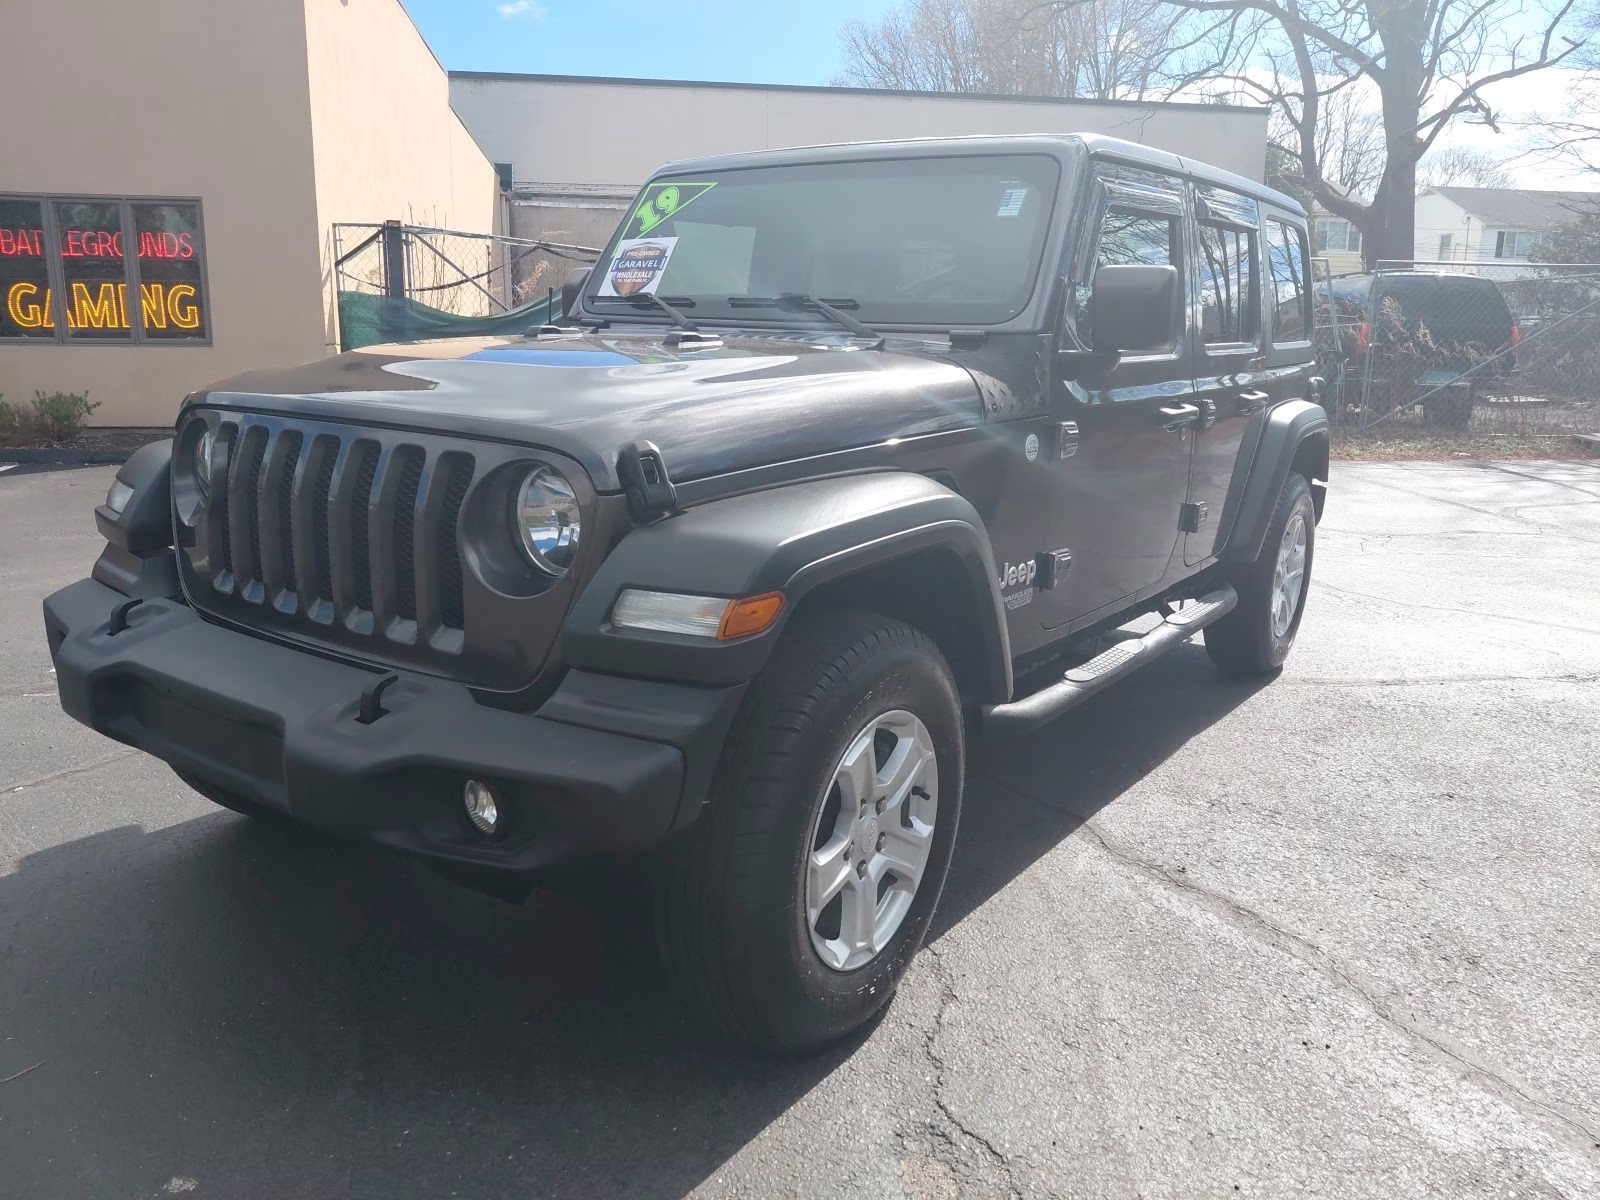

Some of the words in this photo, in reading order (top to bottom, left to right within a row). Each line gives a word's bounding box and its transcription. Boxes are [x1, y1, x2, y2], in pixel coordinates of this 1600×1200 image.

[636, 186, 680, 231] 19
[0, 229, 193, 258] BATEGROUNDS
[616, 271, 654, 279] WHOLESALE
[999, 560, 1036, 589] Jeep
